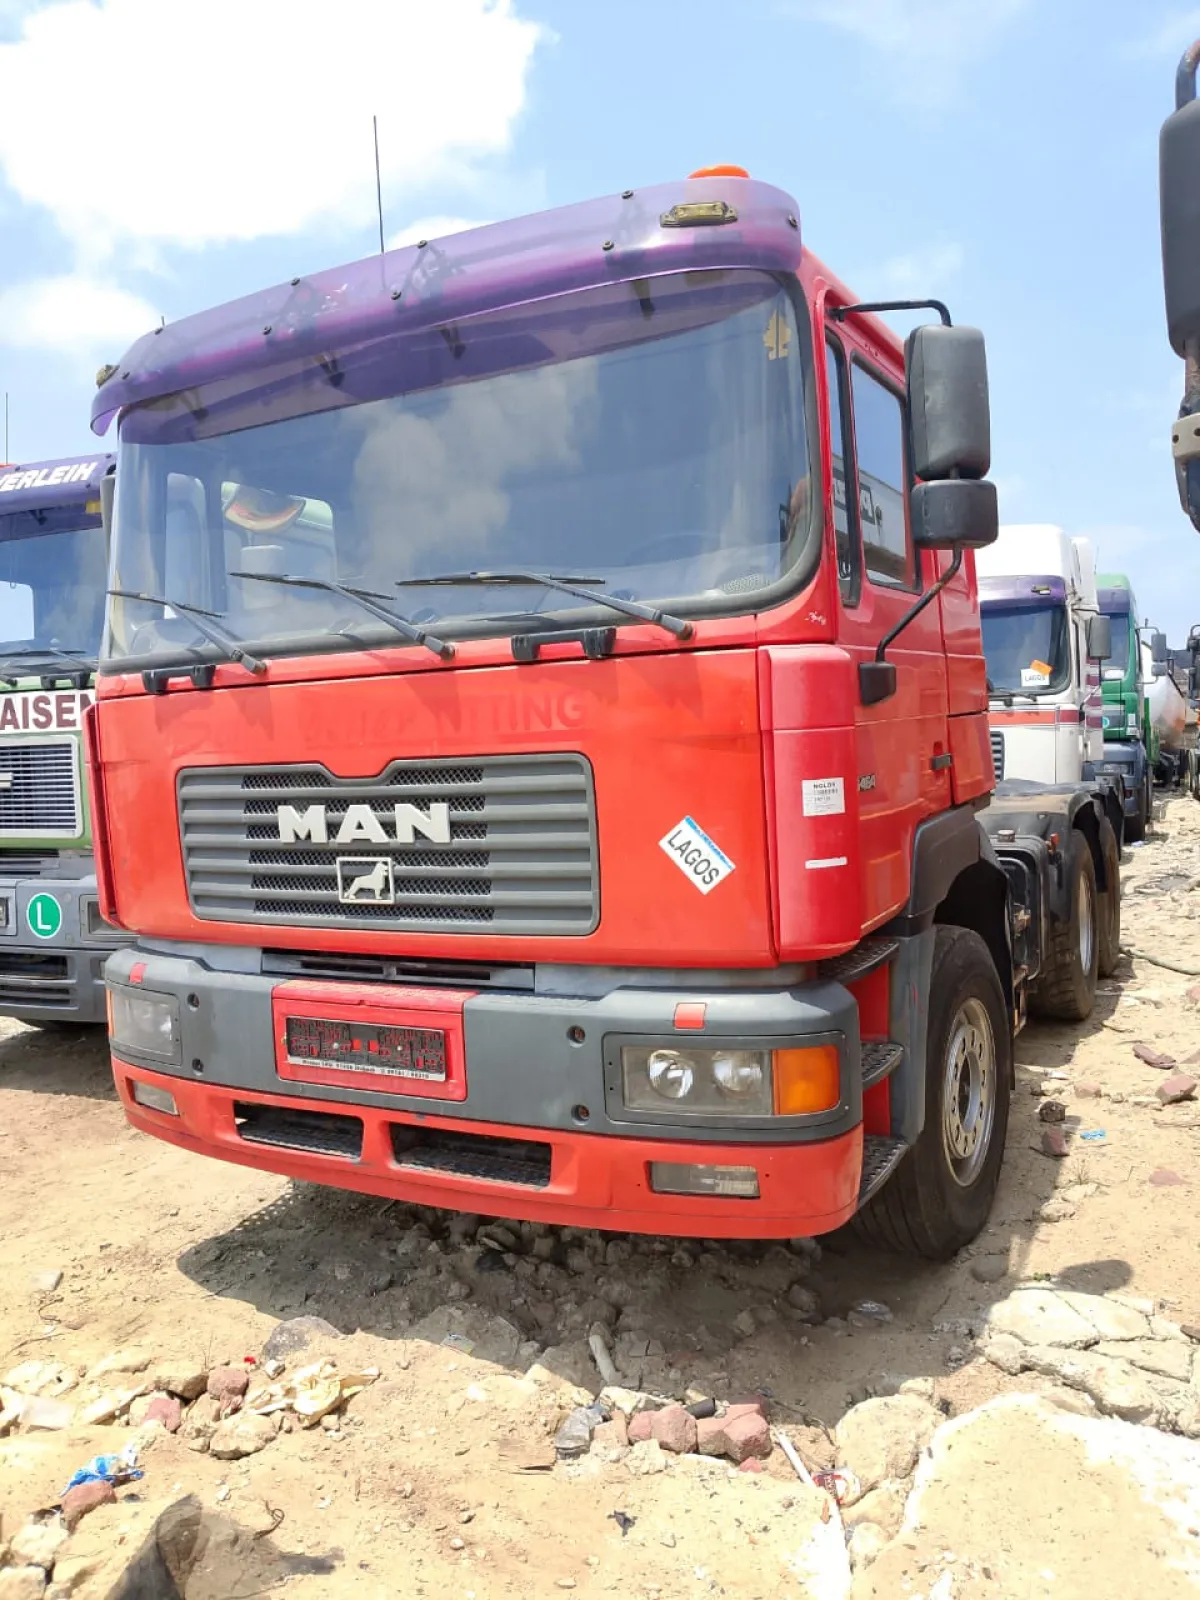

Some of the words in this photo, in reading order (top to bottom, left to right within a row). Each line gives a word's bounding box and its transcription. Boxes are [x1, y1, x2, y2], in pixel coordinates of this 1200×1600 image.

[277, 802, 452, 844] MAN
[667, 829, 720, 885] LAGOS
[36, 902, 51, 931] L
